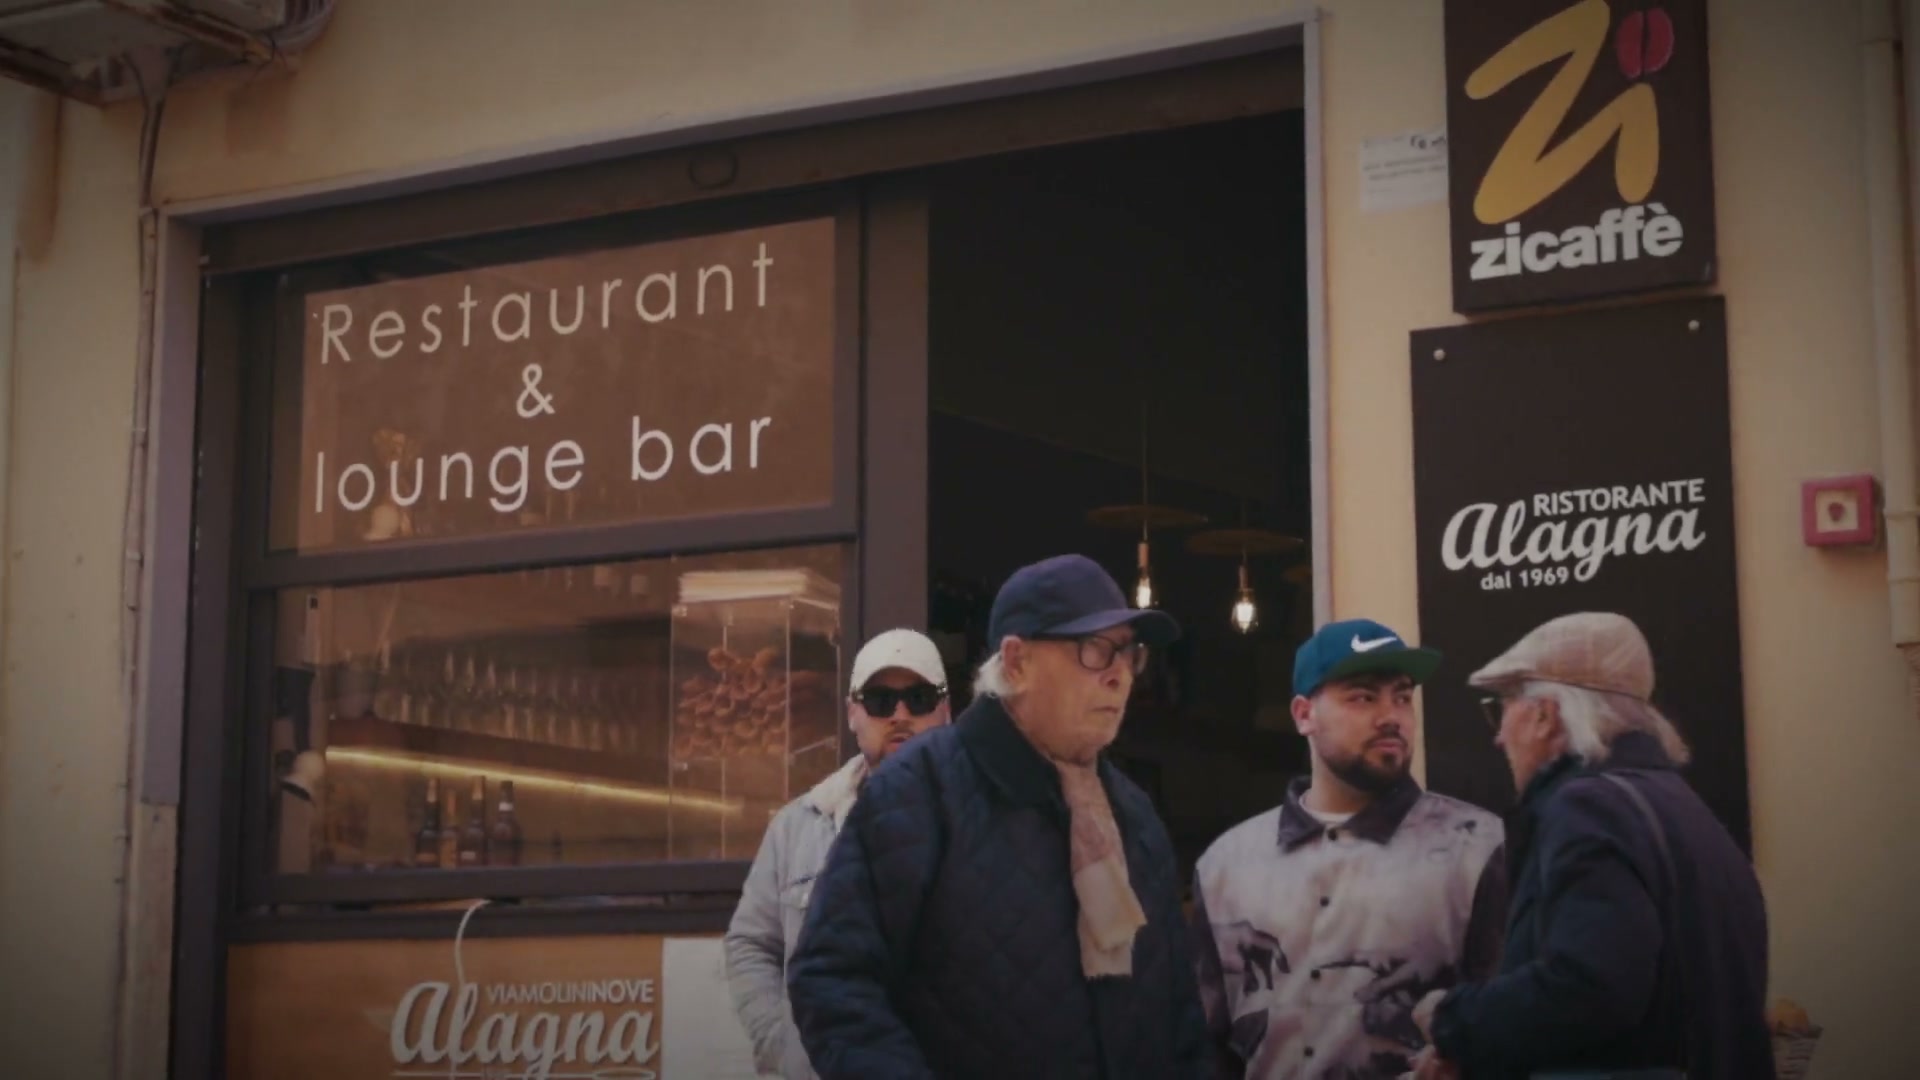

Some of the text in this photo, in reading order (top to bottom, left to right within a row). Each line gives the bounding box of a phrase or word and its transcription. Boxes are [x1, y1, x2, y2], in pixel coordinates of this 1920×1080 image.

[1470, 202, 1684, 281] zicaffè
[320, 242, 774, 364] Restaurant
[515, 363, 555, 418] &
[314, 415, 772, 512] lounge bar
[1532, 478, 1706, 517] RISTORANTE
[1441, 499, 1706, 582] Alagna
[1480, 566, 1569, 590] dal 1969
[390, 980, 660, 1080] Alagna
